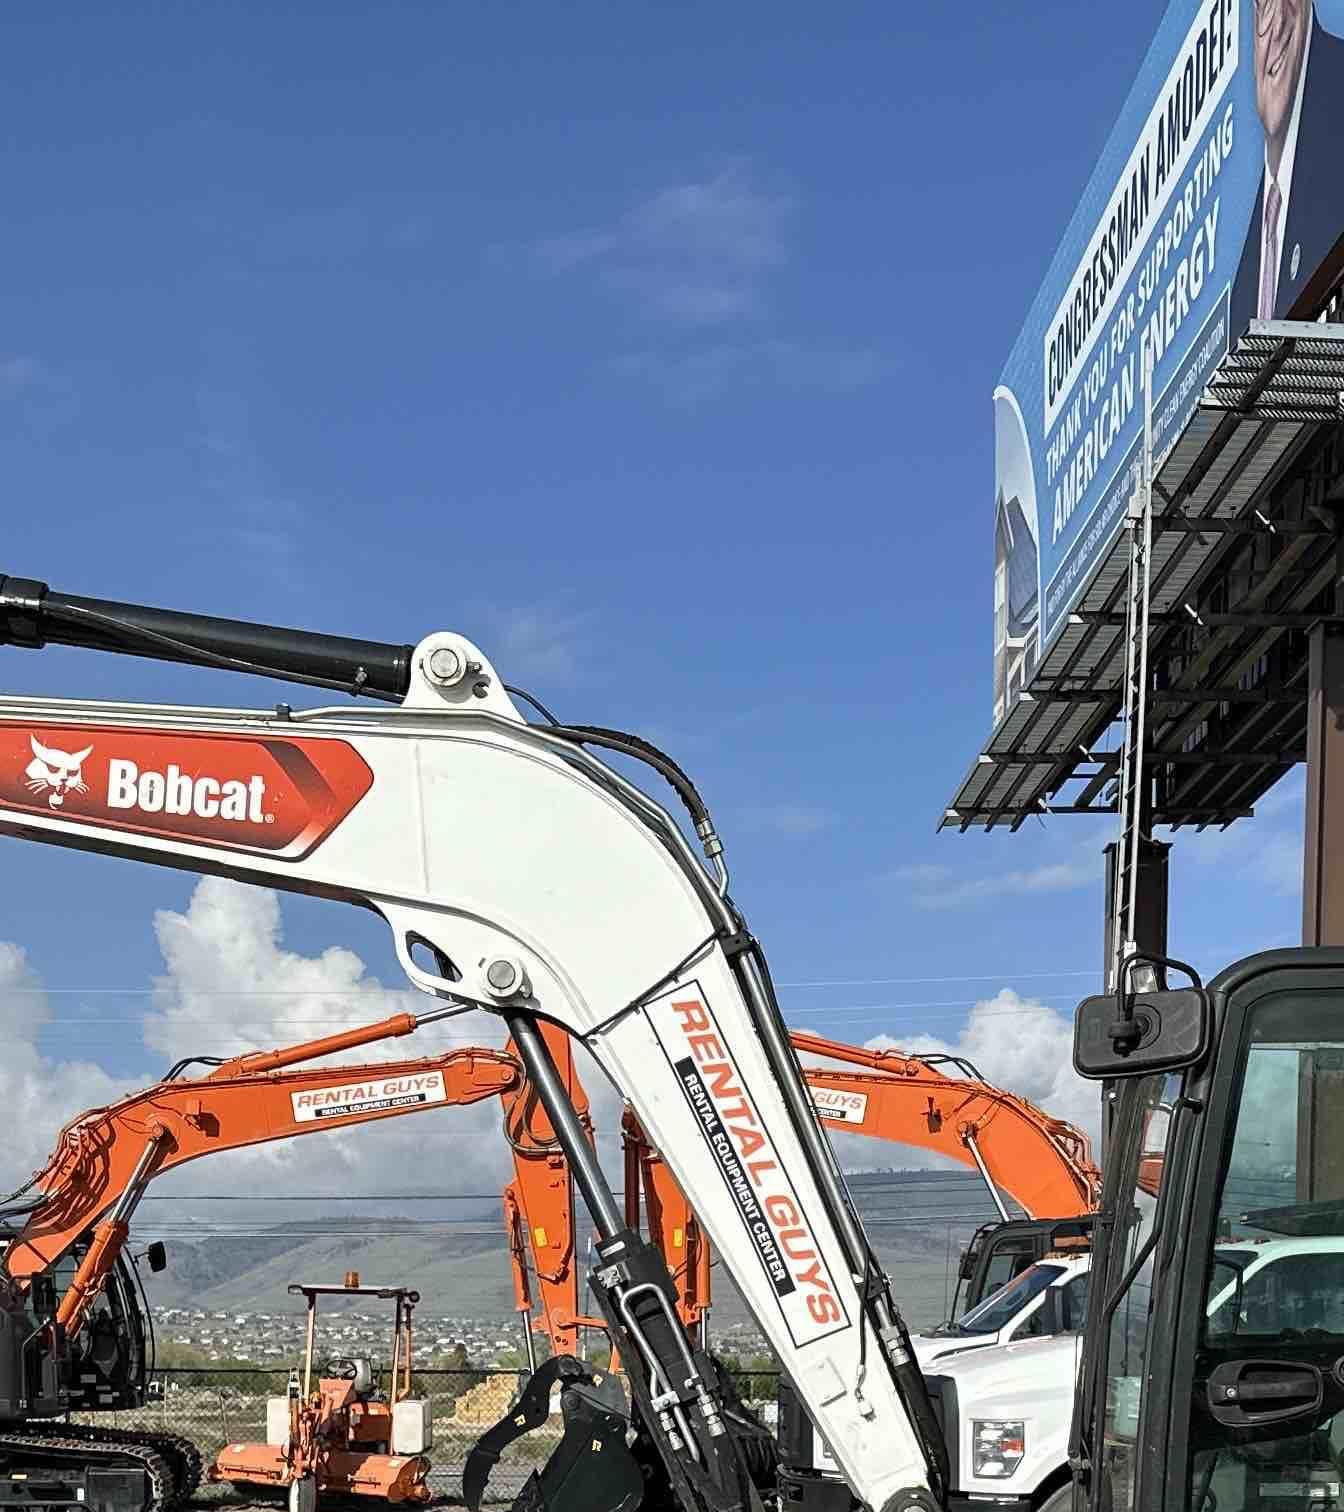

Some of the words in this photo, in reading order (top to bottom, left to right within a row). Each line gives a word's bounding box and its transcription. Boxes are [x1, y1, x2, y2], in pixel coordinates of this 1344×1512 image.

[1047, 405, 1081, 486] THANK
[1083, 342, 1108, 416] YOU
[1111, 292, 1135, 369] FOR
[1137, 101, 1233, 317] SUPPORTING
[1048, 142, 1150, 407] CONGRESSMAN
[1052, 351, 1135, 544] AMERICAN
[107, 758, 266, 823] Bobcat
[297, 1086, 378, 1108] RENTAL
[383, 1075, 439, 1096] GUYS
[672, 999, 777, 1186] RENTAL
[765, 1194, 841, 1324] GUYS
[684, 1073, 714, 1135] RENTAL
[712, 1133, 752, 1224] EQUIPMENT
[753, 1221, 787, 1283] CENTER
